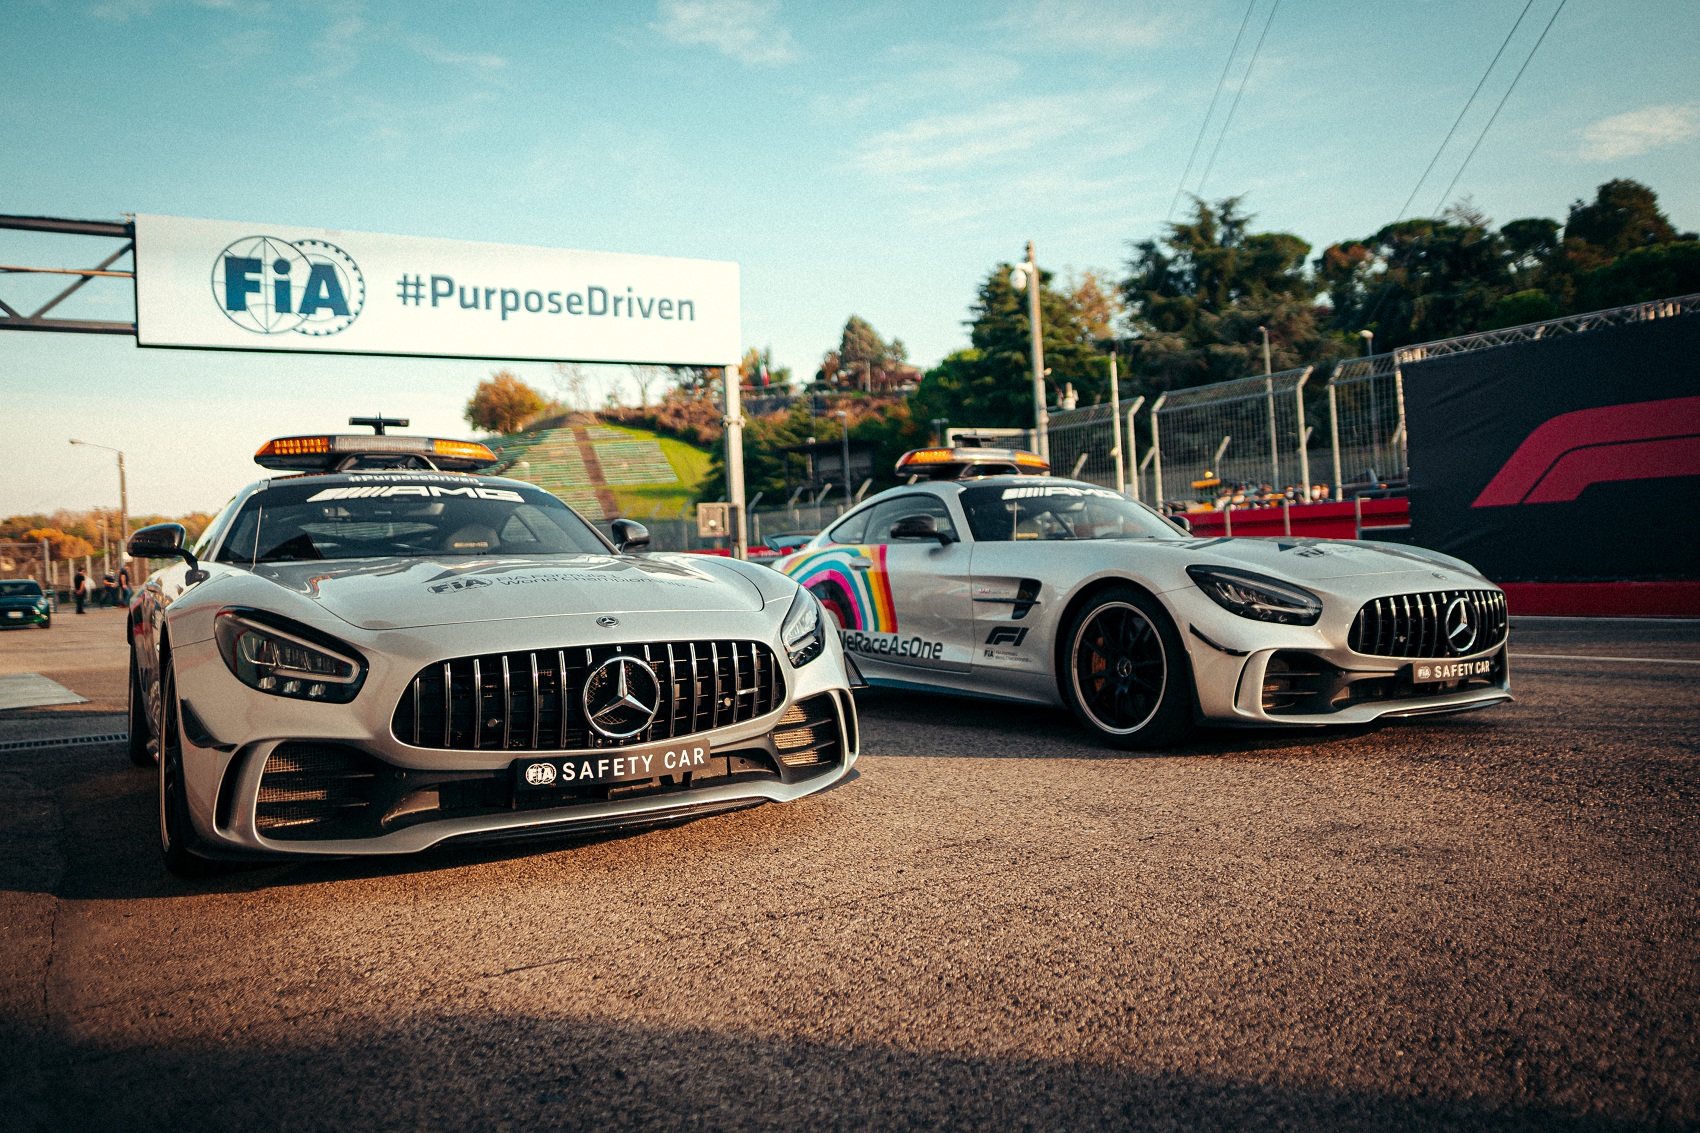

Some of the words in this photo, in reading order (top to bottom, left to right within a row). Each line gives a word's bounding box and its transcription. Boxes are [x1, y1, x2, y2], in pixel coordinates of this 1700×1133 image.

[396, 273, 696, 321] #PurposeDriven
[348, 475, 480, 484] #PurposeDriven
[381, 485, 525, 503] AMG
[1434, 662, 1474, 679] SAFETY
[1475, 660, 1490, 674] CAR
[562, 754, 654, 781] SAFETY
[664, 748, 705, 769] CAR
